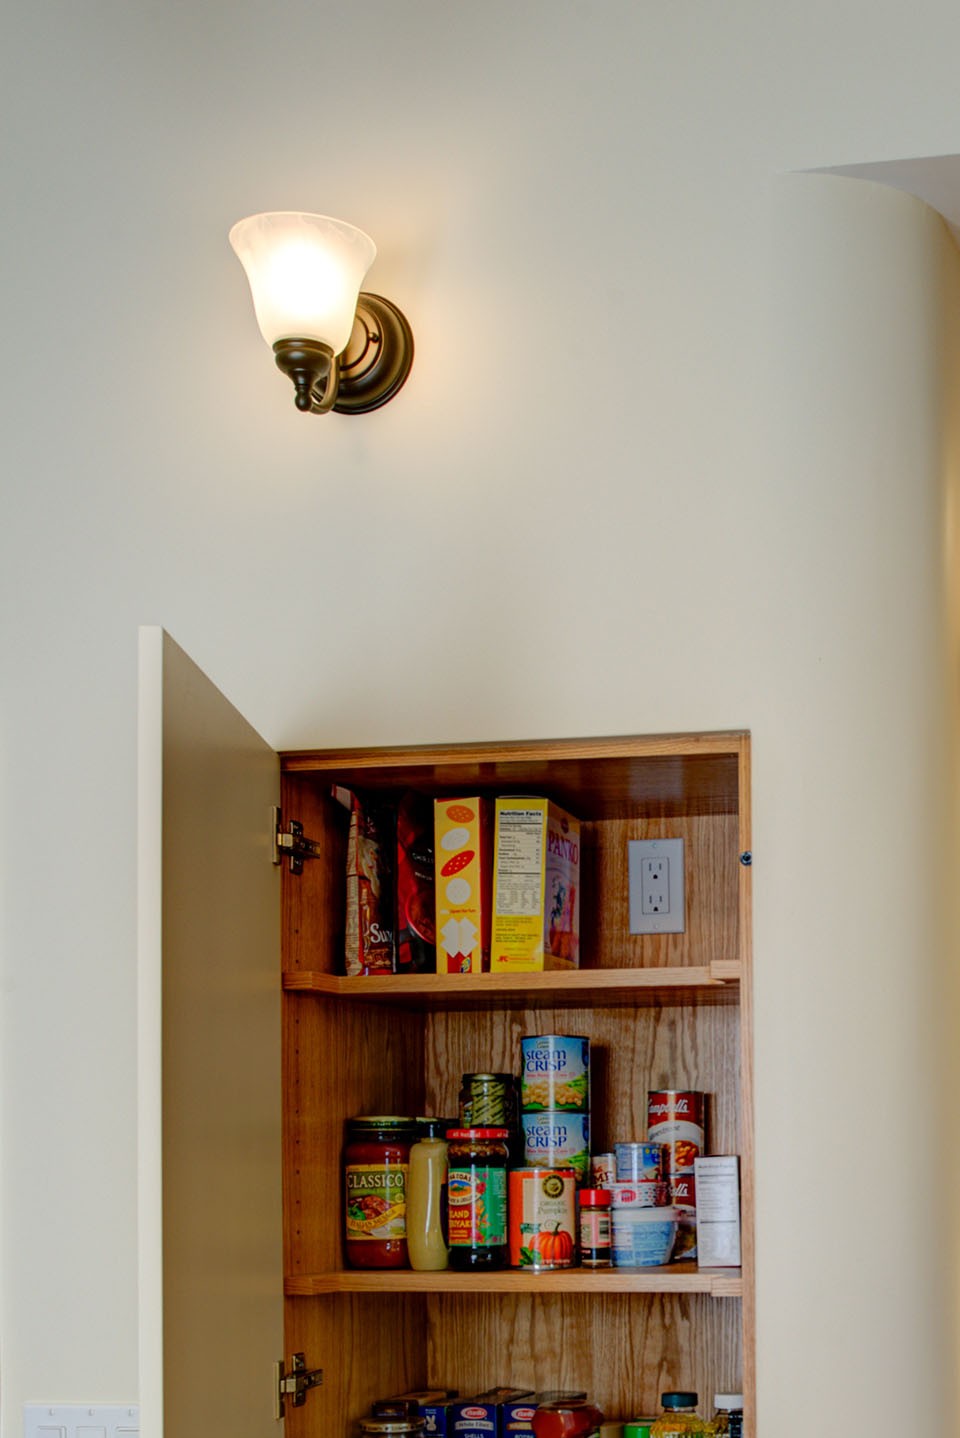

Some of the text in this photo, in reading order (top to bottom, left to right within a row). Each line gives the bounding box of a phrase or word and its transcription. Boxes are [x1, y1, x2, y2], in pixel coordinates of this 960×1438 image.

[526, 1049, 566, 1060] steam
[526, 1060, 566, 1072] CRISP
[526, 1126, 567, 1136] steam
[526, 1136, 567, 1147] CRISP
[348, 1174, 404, 1188] CLASSICO
